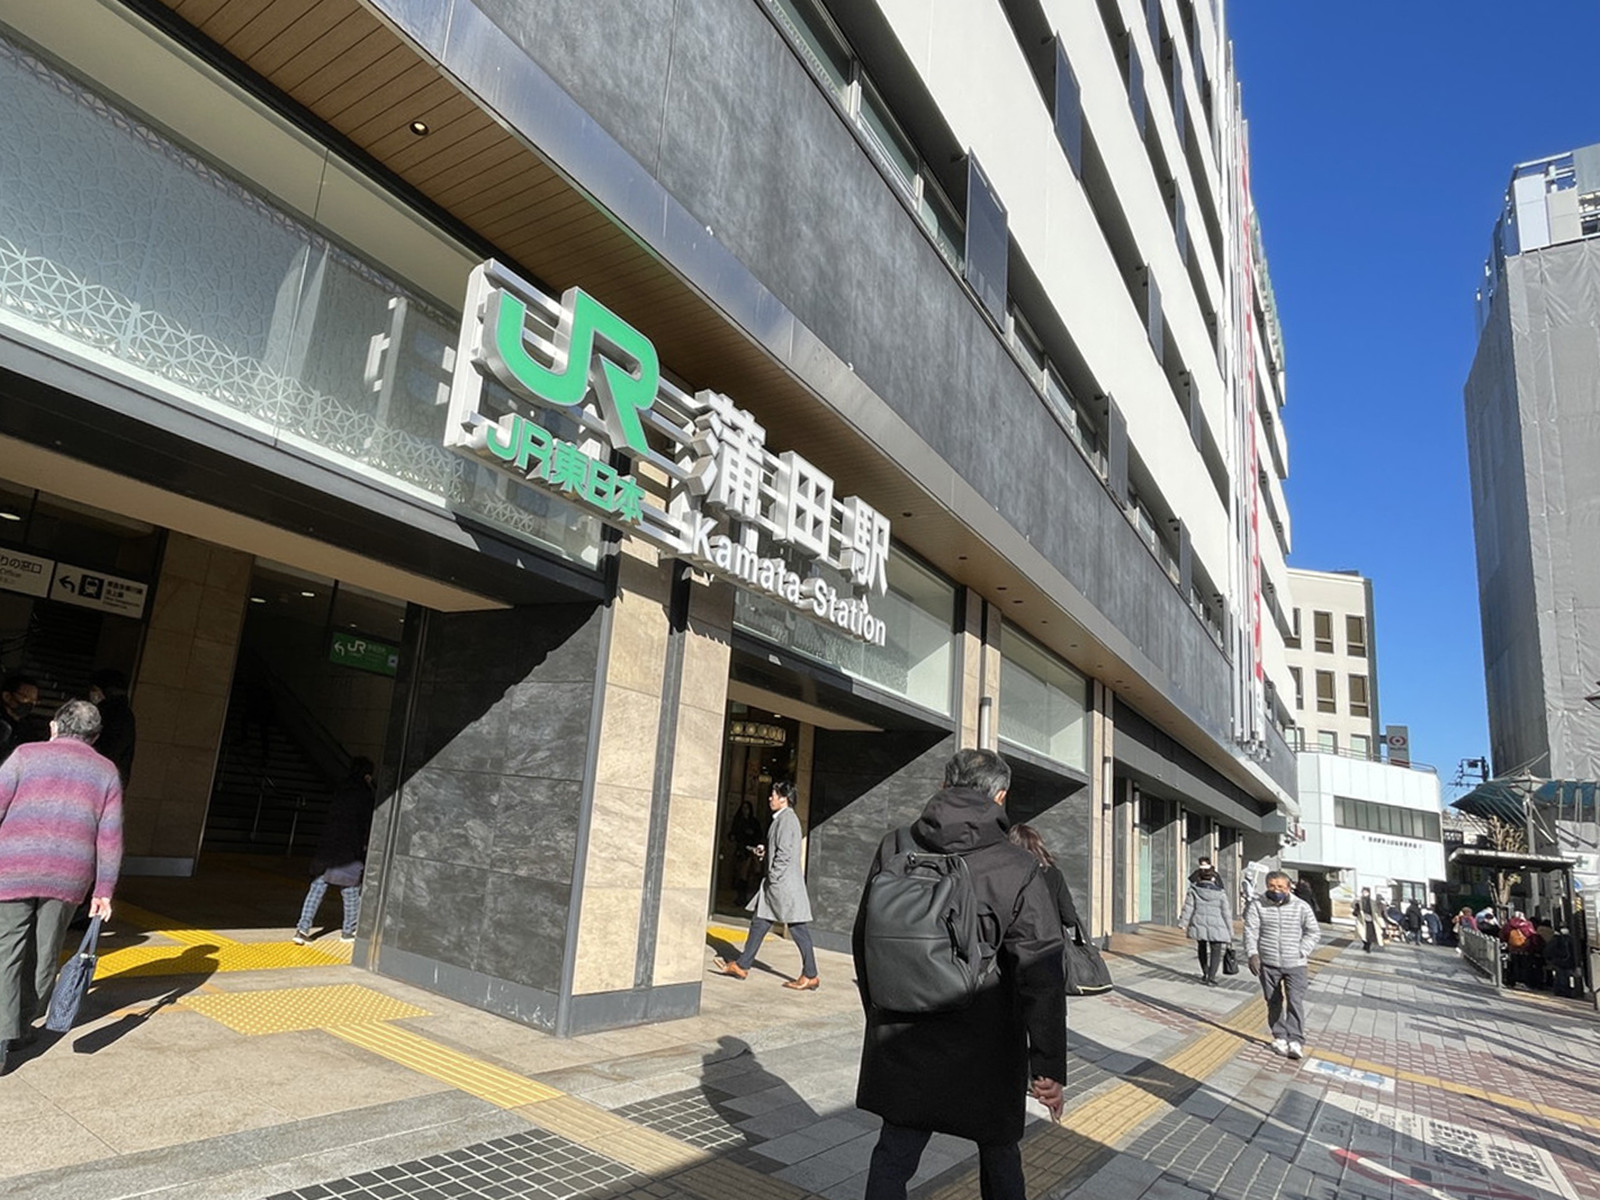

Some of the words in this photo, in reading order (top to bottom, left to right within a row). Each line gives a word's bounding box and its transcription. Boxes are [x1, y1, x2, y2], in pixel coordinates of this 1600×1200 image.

[498, 287, 659, 456] JR
[486, 413, 645, 526] JR東日本
[692, 389, 890, 597] 蒲田駅
[693, 510, 800, 604] Kamata
[813, 577, 886, 646] Station
[347, 640, 366, 654] JR
